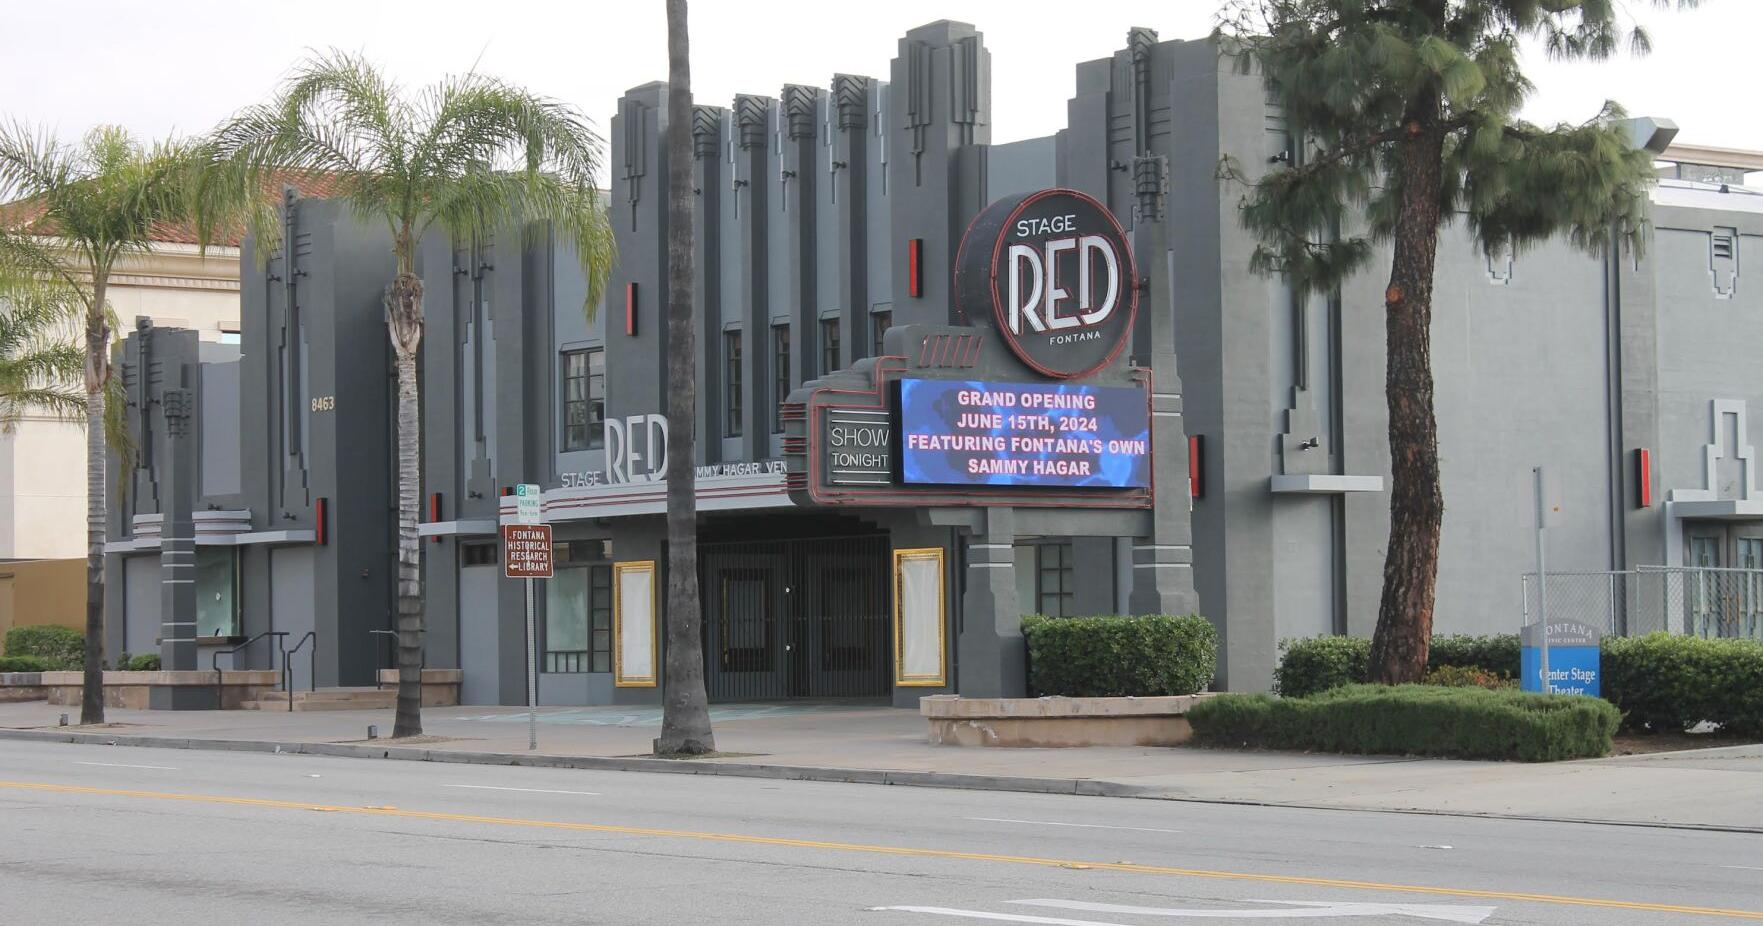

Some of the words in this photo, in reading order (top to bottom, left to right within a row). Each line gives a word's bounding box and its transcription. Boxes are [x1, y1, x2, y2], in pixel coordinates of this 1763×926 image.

[1017, 215, 1076, 237] STAGE
[1009, 235, 1119, 335] RED
[1050, 331, 1101, 345] FONTANA
[312, 396, 334, 412] 8463
[958, 391, 1016, 407] GRAND
[1021, 393, 1095, 409] OPENING
[957, 414, 1002, 429] JUNE
[1008, 416, 1055, 434] 15TH,
[1060, 416, 1098, 432] 2024
[831, 427, 889, 447] SHOW
[908, 435, 1006, 452] FEATURING
[1011, 437, 1103, 454] FONTANA'S
[1109, 441, 1145, 455] OWN
[561, 471, 601, 488] STAGE
[604, 414, 668, 484] RED
[695, 465, 719, 479] MMY
[723, 462, 759, 476] HAGAR
[766, 460, 788, 473] VEN
[831, 452, 888, 467] TONIGHT
[968, 458, 1028, 474] SAMMY
[1033, 460, 1090, 476] HAGAR
[519, 486, 526, 495] 2
[512, 530, 545, 540] FONTANA
[508, 541, 550, 551] HISTORICAL
[511, 551, 548, 561] RESEARCH
[518, 562, 548, 571] LIBRARY
[1545, 623, 1592, 640] ONTANA
[1571, 667, 1595, 684] Stage
